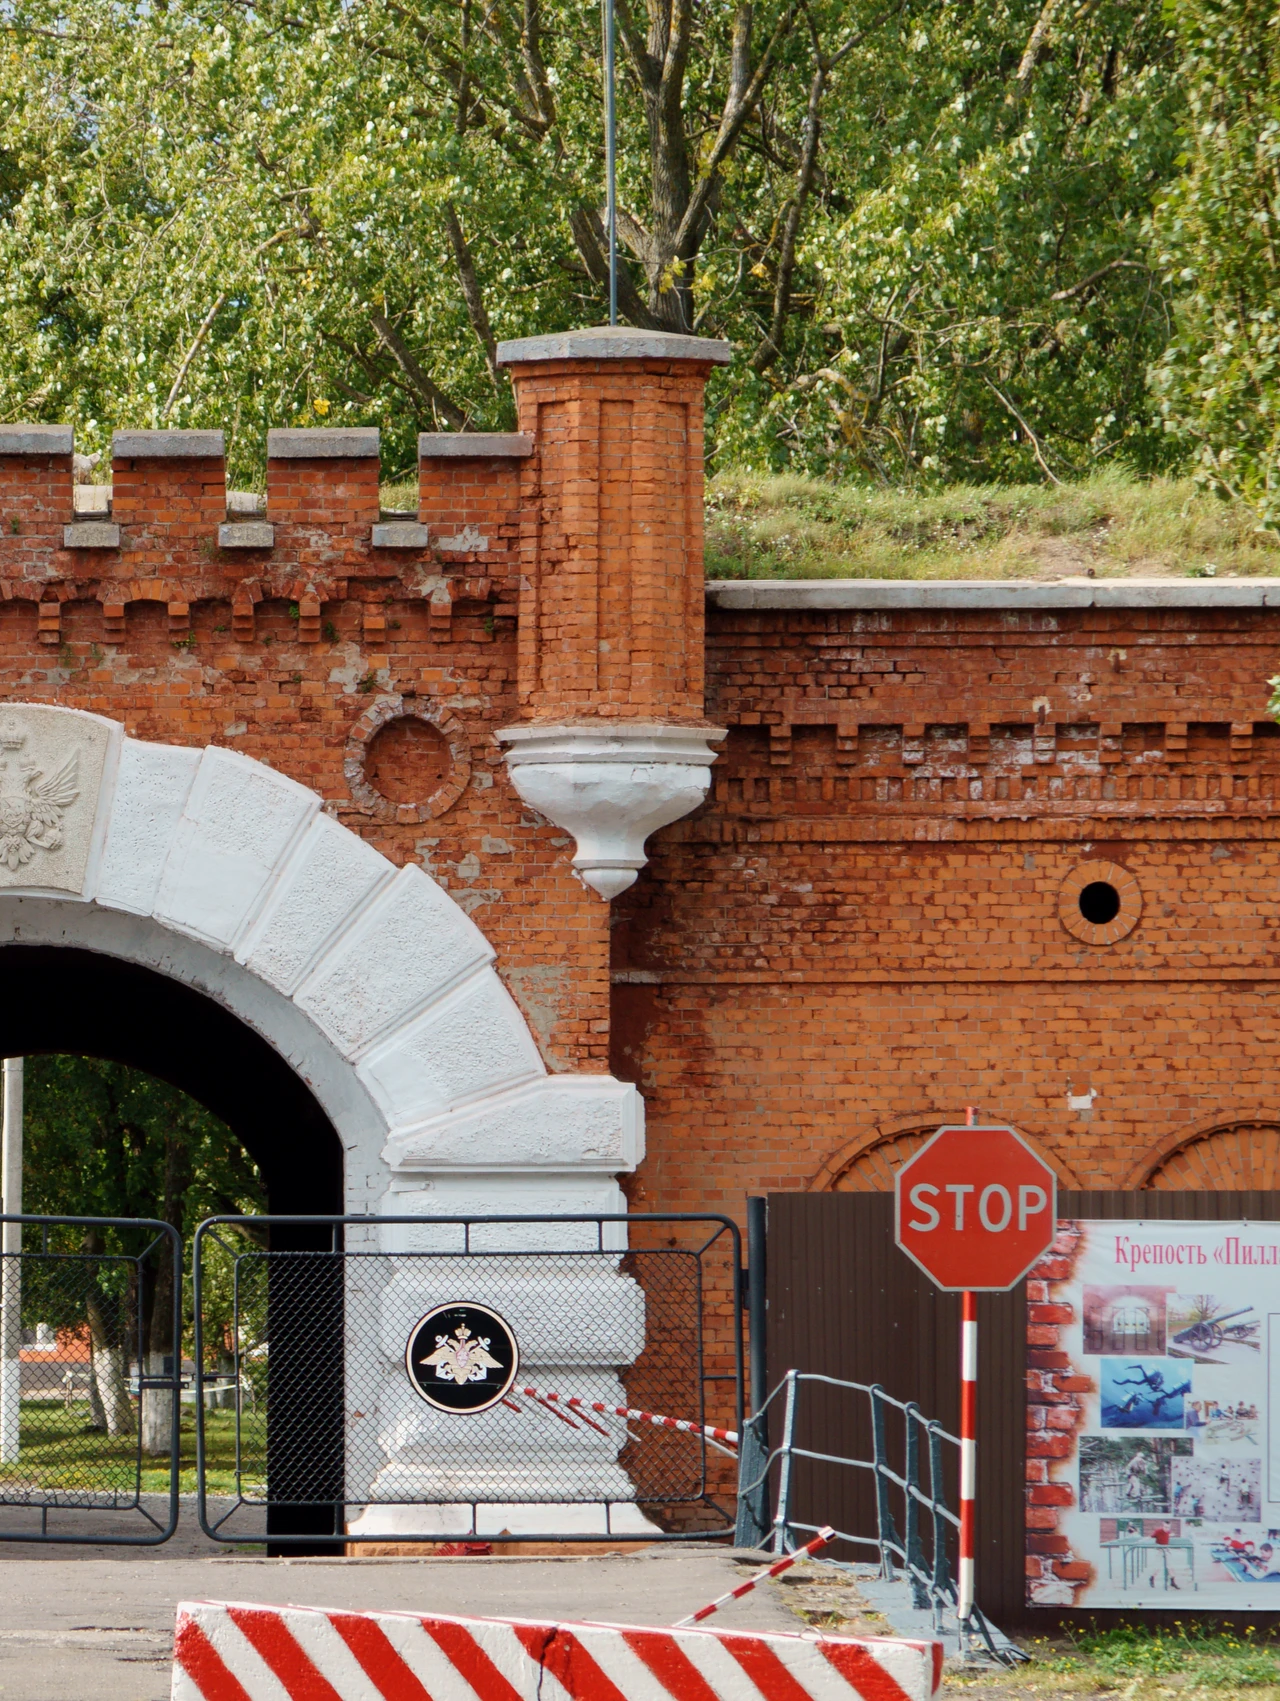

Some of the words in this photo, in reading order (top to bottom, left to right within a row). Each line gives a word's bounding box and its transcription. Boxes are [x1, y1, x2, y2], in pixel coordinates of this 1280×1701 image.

[908, 1183, 1047, 1232] STOP
[1115, 1236, 1207, 1272] Крепость
[1213, 1237, 1280, 1265] «Пилл
